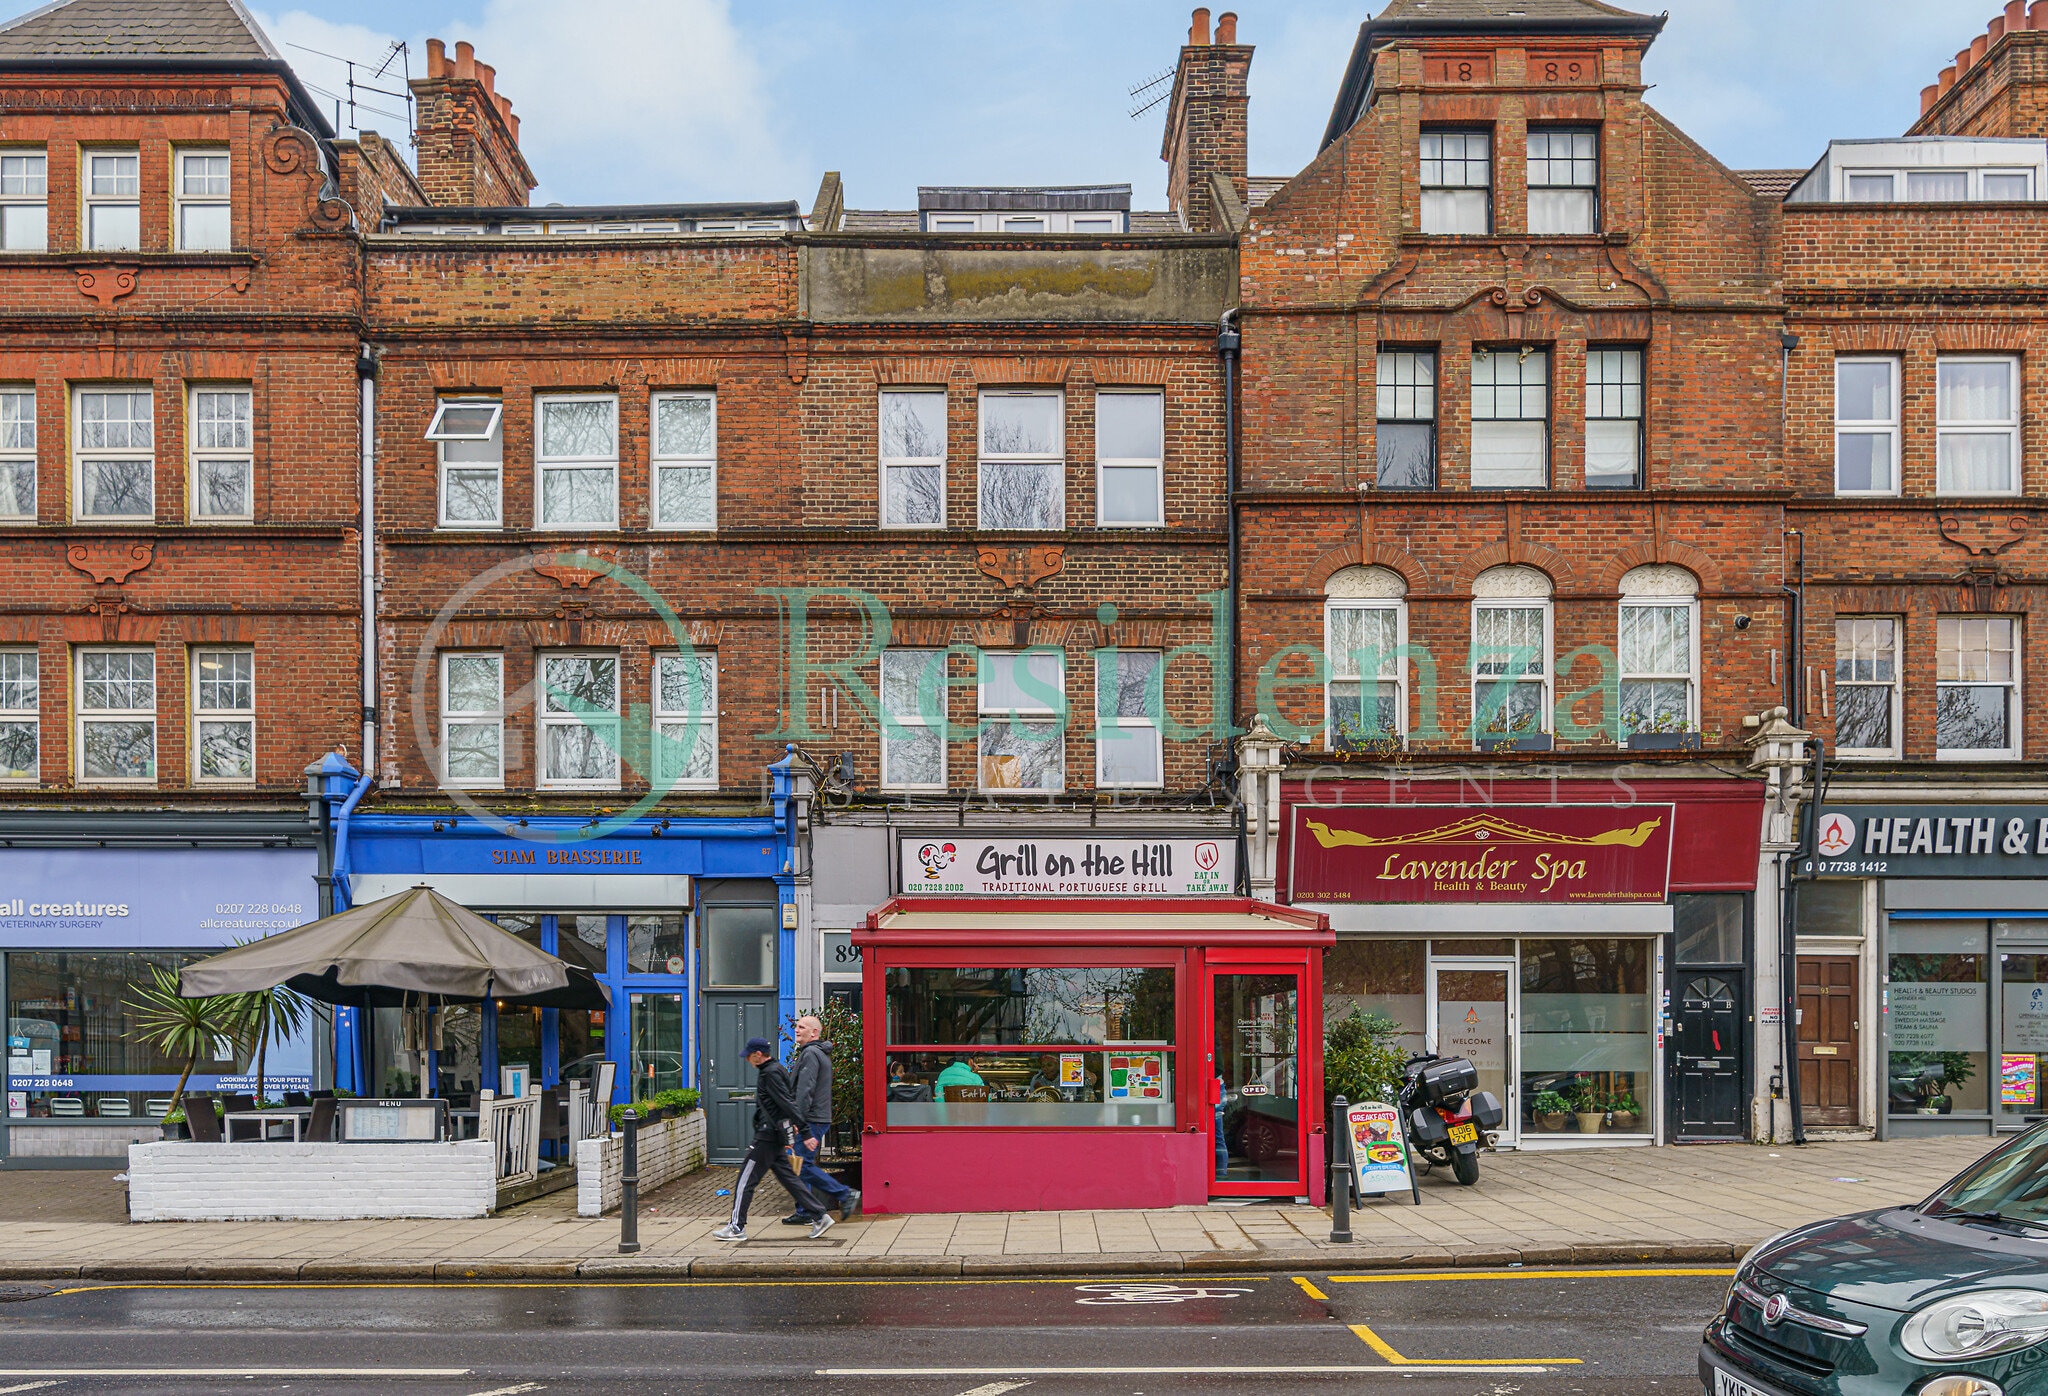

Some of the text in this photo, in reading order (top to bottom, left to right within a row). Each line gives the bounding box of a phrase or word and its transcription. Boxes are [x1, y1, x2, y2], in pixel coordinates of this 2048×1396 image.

[1443, 62, 1583, 82] 18 89
[1863, 817, 1997, 854] HEALTH
[2002, 816, 2030, 855] &
[761, 847, 772, 856] 87
[491, 849, 642, 865] SIAM BRASSERIE
[976, 843, 1173, 880] Grill on the Hill
[1375, 846, 1588, 893] Lavender Spa
[1805, 861, 1888, 873] 00 7738 1412
[1194, 871, 1220, 880] EAT IN
[908, 883, 964, 892] 020 7228 2002
[982, 882, 1168, 893] TRADITIONAL PORTUGUESE GRILL
[1186, 883, 1229, 892] TAKE AWAY
[1433, 880, 1528, 894] Health & Beauty
[1568, 891, 1662, 900] www.lavenderthaispa.co.uk
[0, 899, 130, 917] all creatures
[215, 903, 302, 914] 0207 228 0648
[0, 920, 103, 929] VETERINARY SURGERY
[200, 919, 303, 929] allcreatures.co.uk
[1701, 1001, 1711, 1009] 91
[1725, 1001, 1732, 1009] B
[2030, 1001, 2044, 1010] 93
[12, 1079, 73, 1087] 0207 228 0648
[961, 1089, 978, 1098] Eat
[979, 1089, 987, 1097] In
[999, 1089, 1021, 1098] Take
[1023, 1089, 1047, 1099] Away
[1351, 1112, 1395, 1122] BREAKFASTS
[1451, 1125, 1472, 1135] LD16
[1455, 1132, 1473, 1143] ZYT
